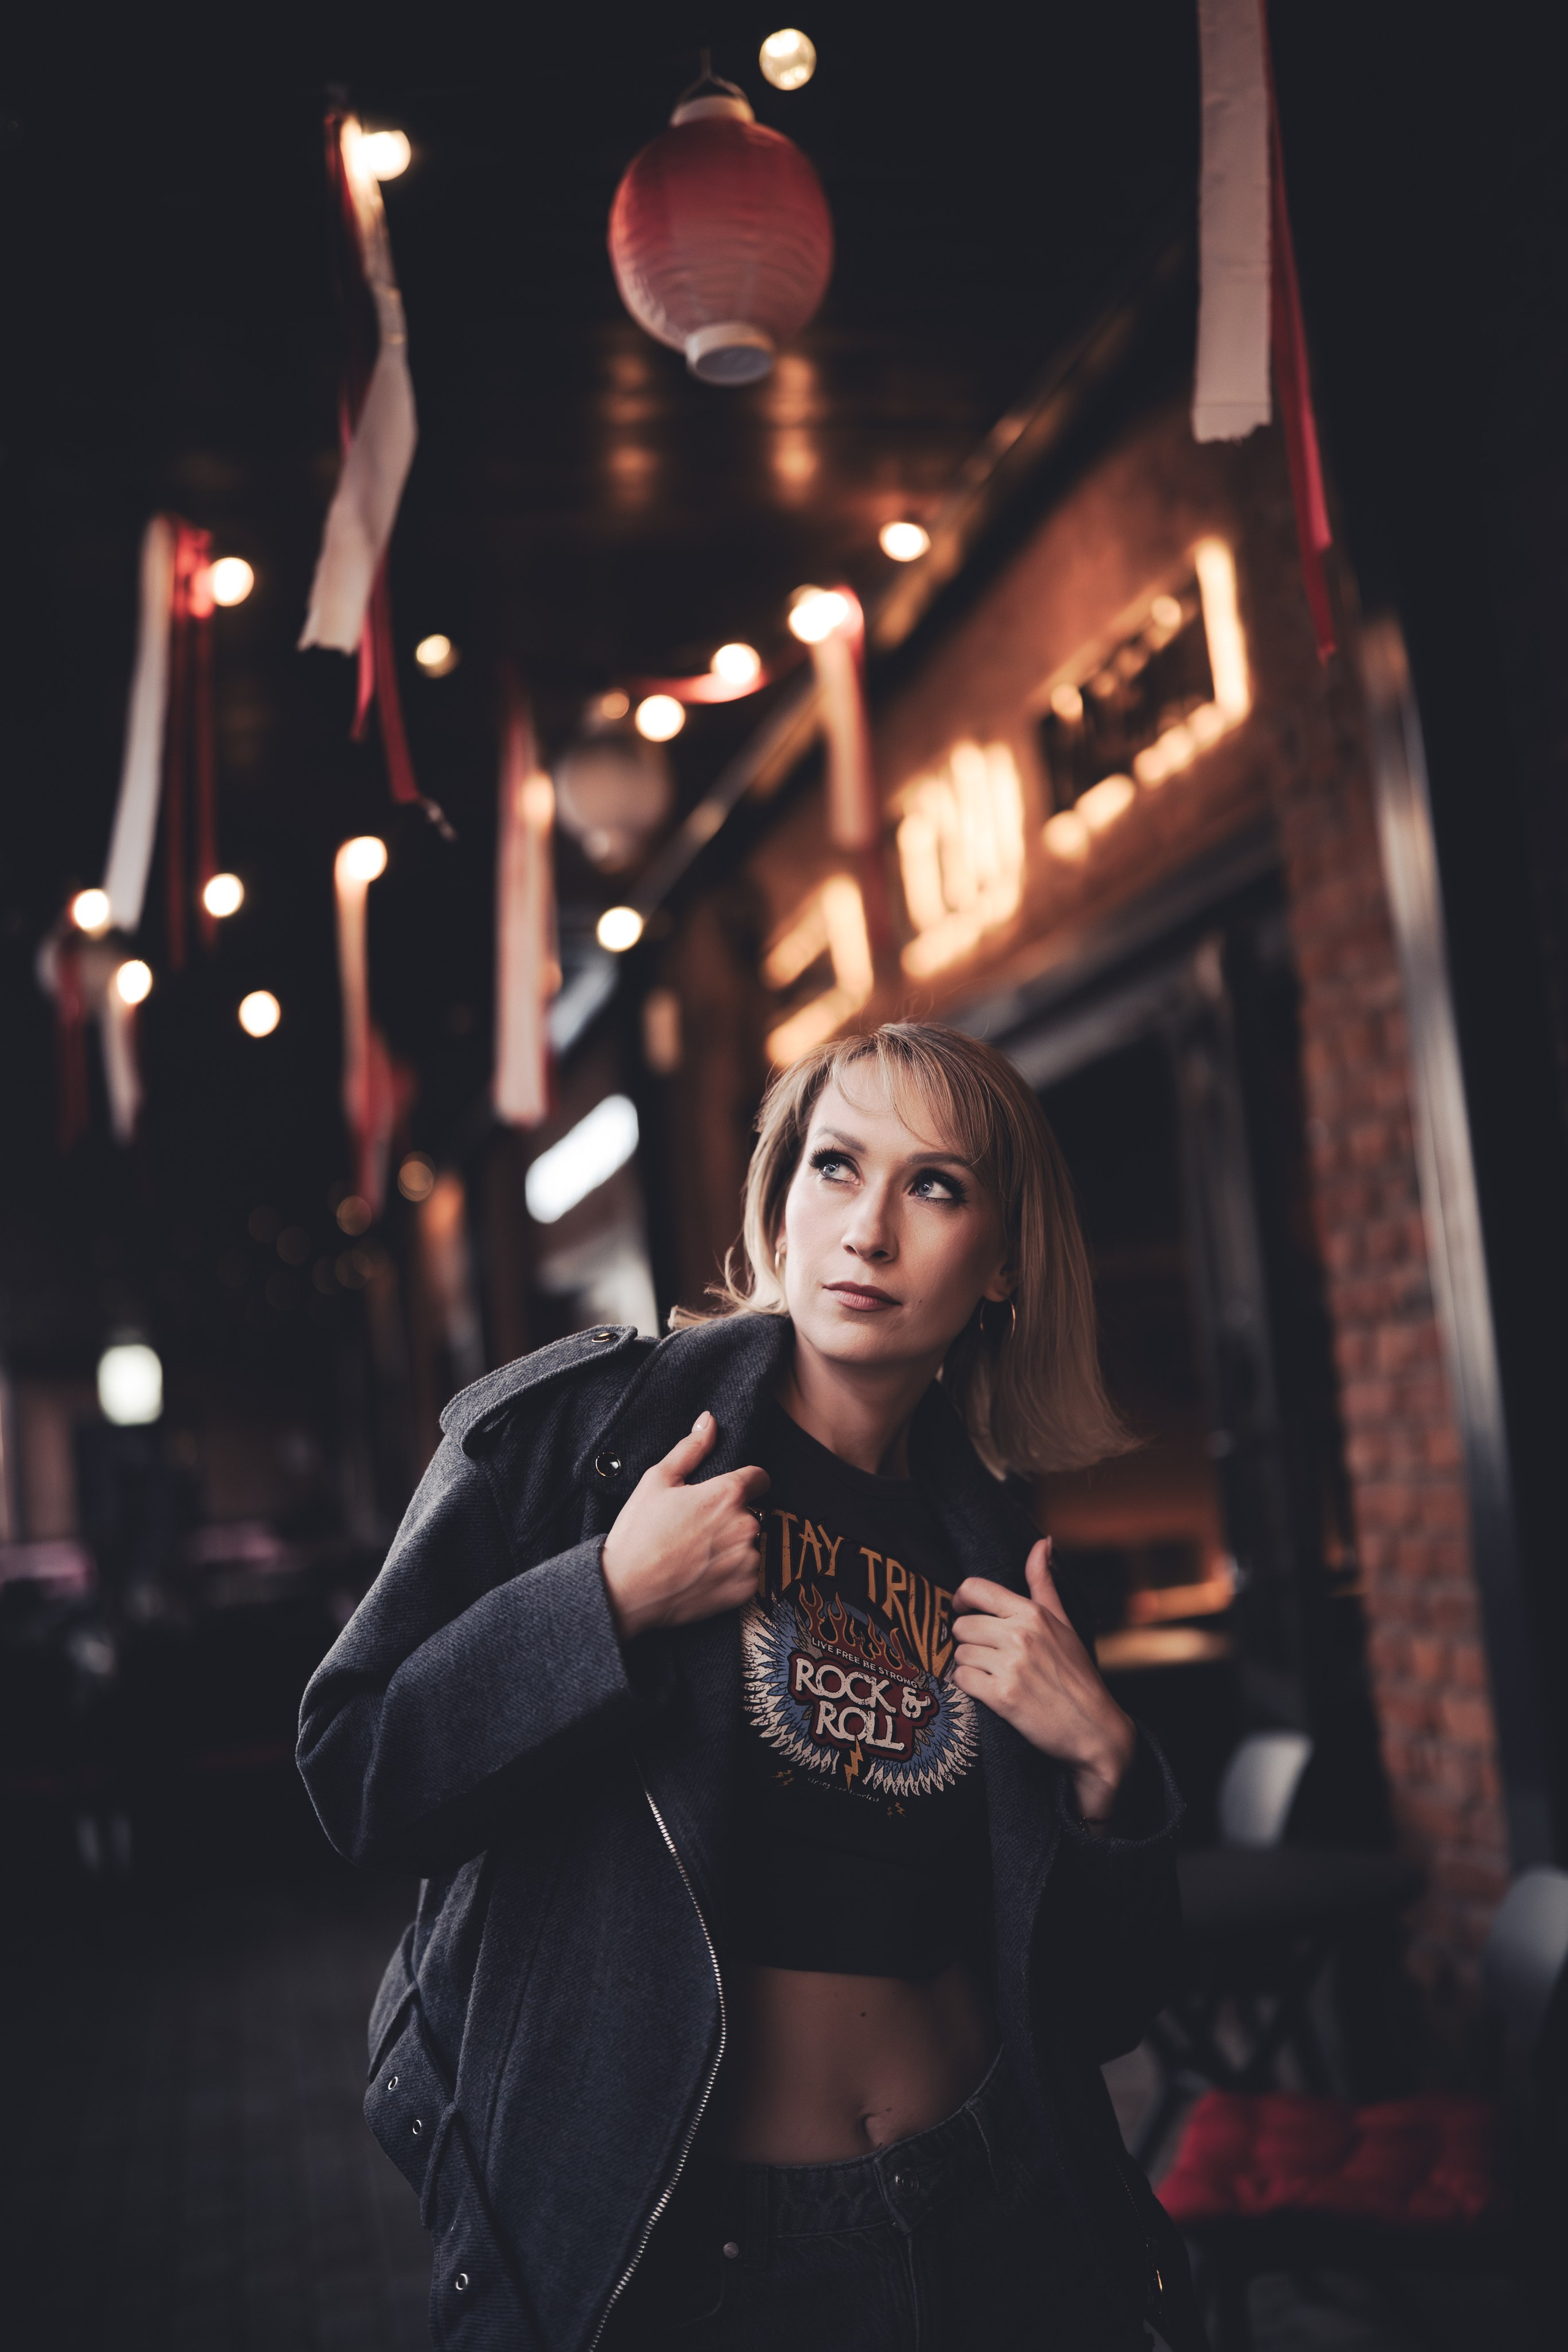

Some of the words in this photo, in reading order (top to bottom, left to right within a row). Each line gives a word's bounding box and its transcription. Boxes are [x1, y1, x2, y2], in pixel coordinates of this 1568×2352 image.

[859, 1547, 954, 1679] TRUE
[795, 1657, 897, 1713] ROCK
[901, 1686, 931, 1718] &
[812, 1637, 834, 1653] LIVE
[836, 1648, 860, 1664] FREE
[863, 1660, 876, 1671] BE
[878, 1667, 918, 1688] STRONG
[815, 1701, 905, 1751] ROLL
